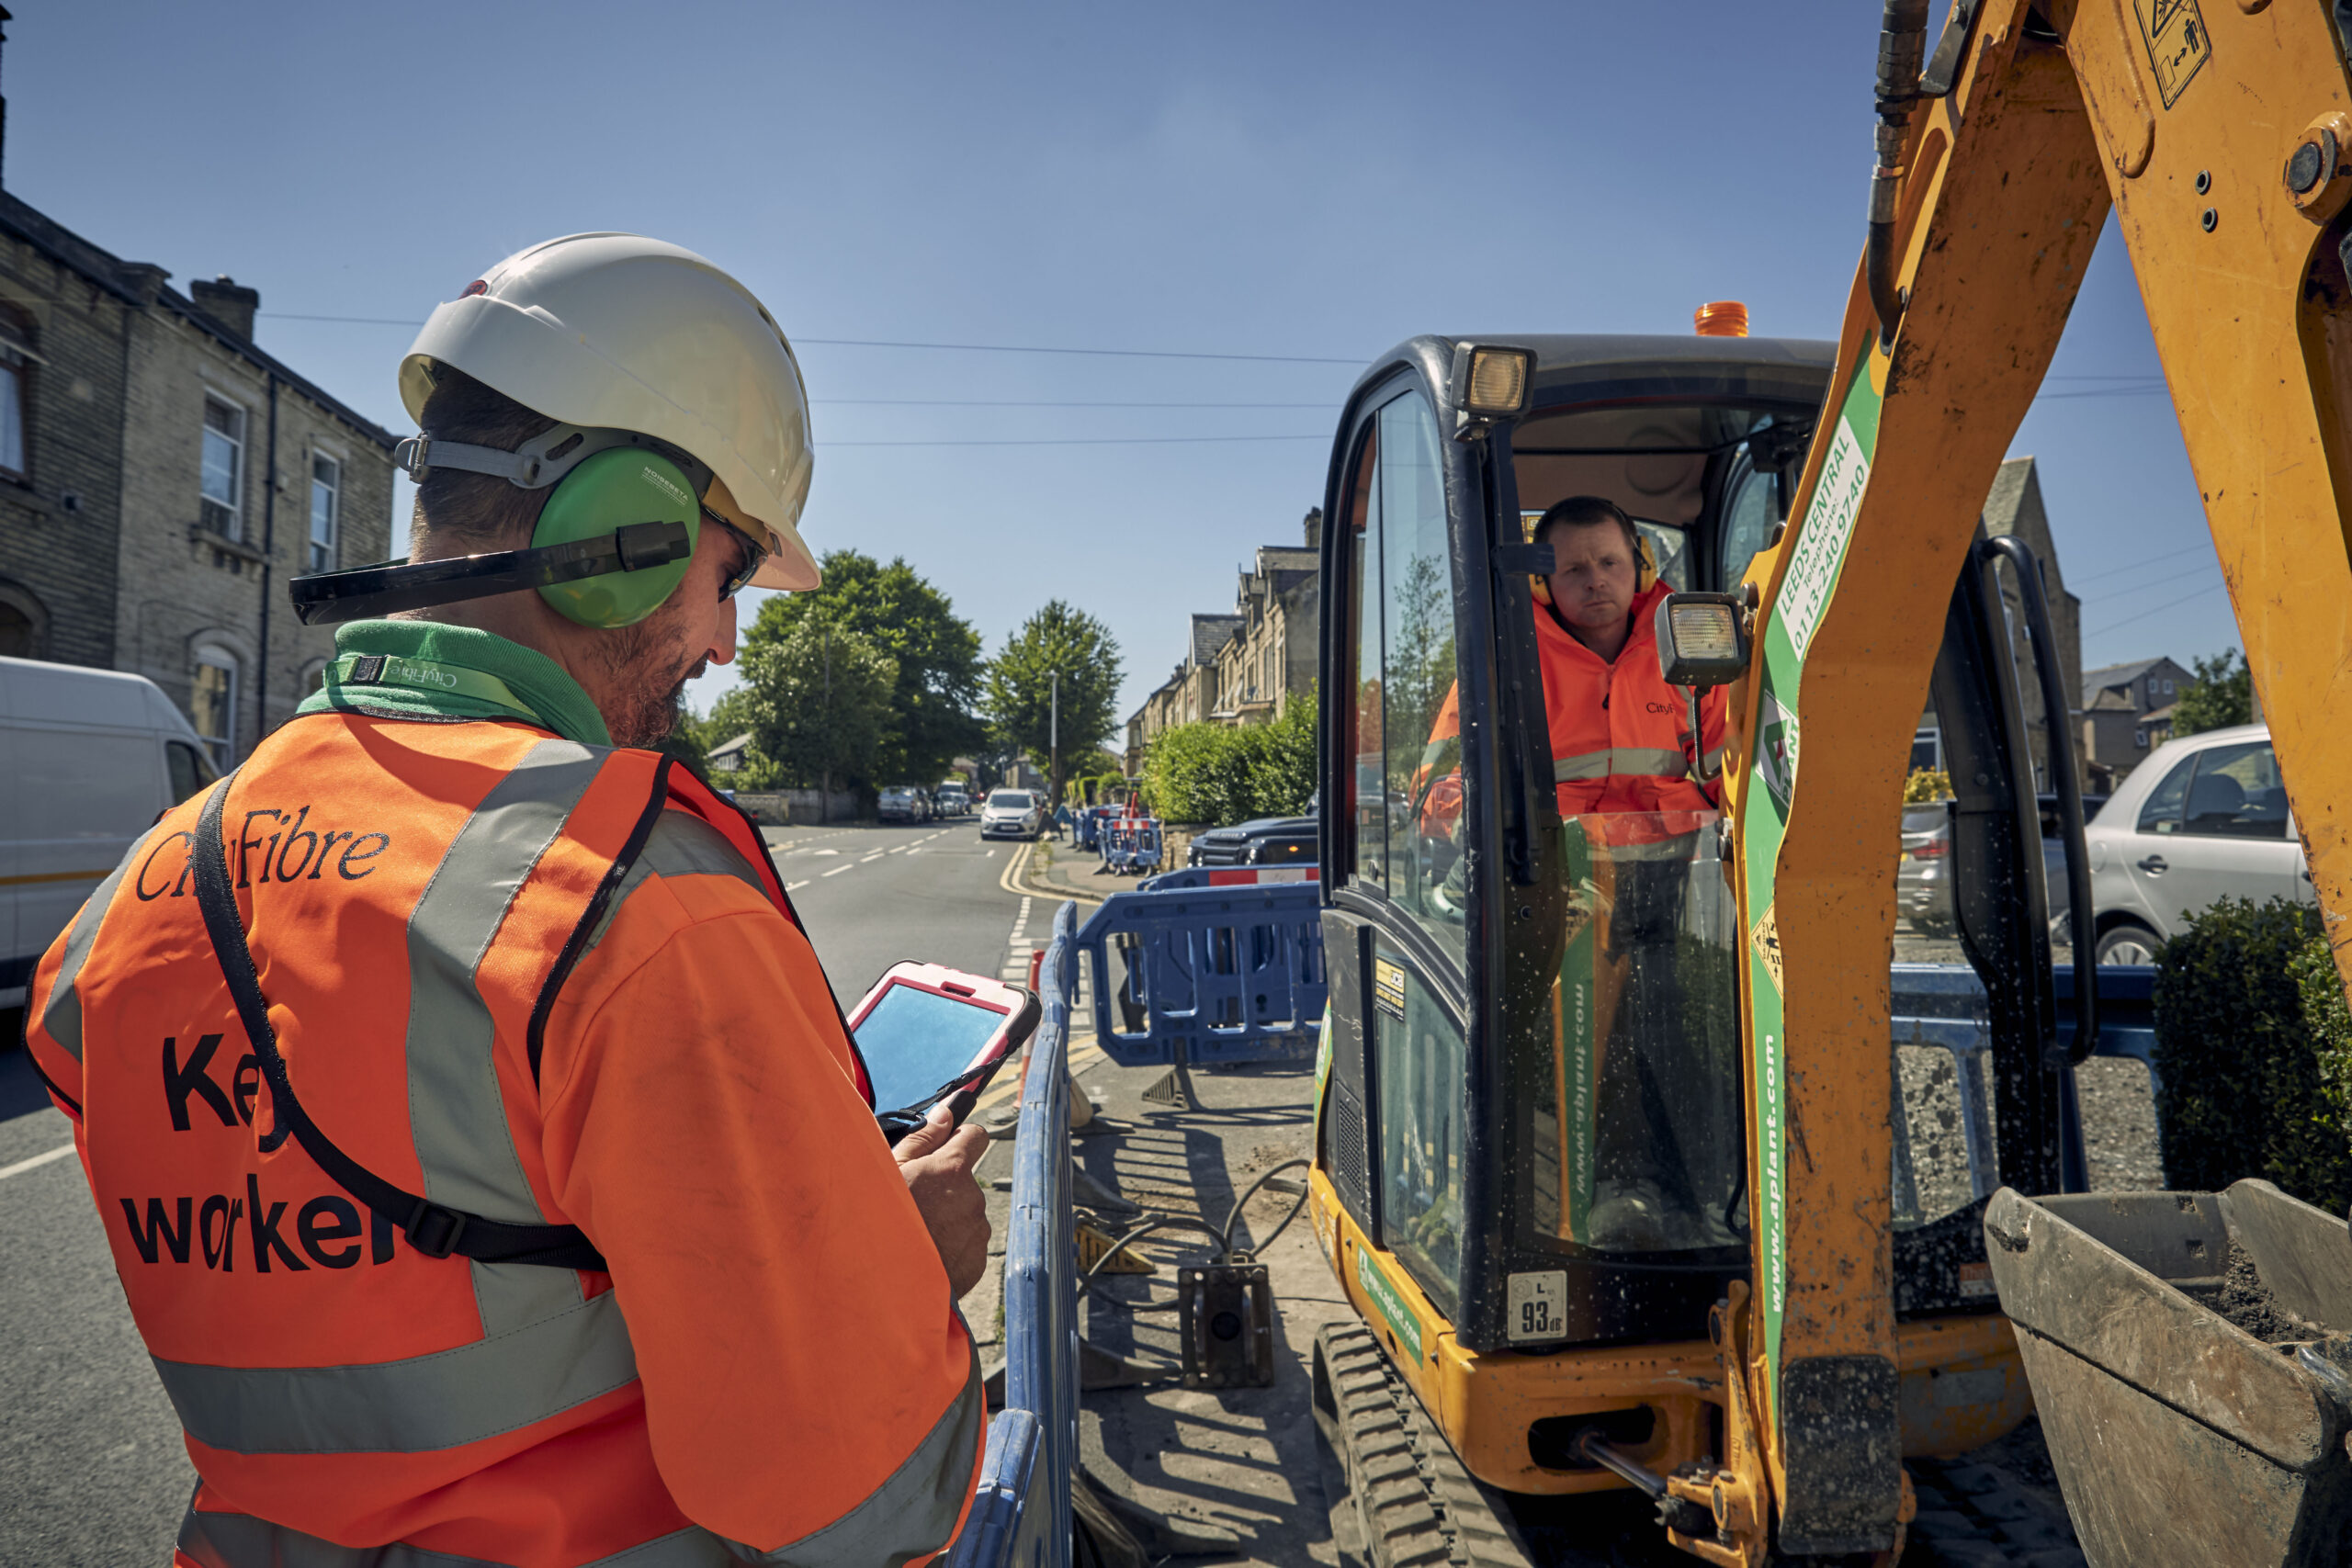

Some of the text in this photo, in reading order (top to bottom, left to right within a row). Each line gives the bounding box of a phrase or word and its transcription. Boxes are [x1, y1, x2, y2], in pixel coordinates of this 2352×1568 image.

[1781, 436, 1849, 615] LEEDS CENTRAL
[1795, 464, 1865, 650] 0113-240 9740
[1804, 498, 1839, 588] Telephone:
[1765, 1034, 1781, 1313] www.aplant.com
